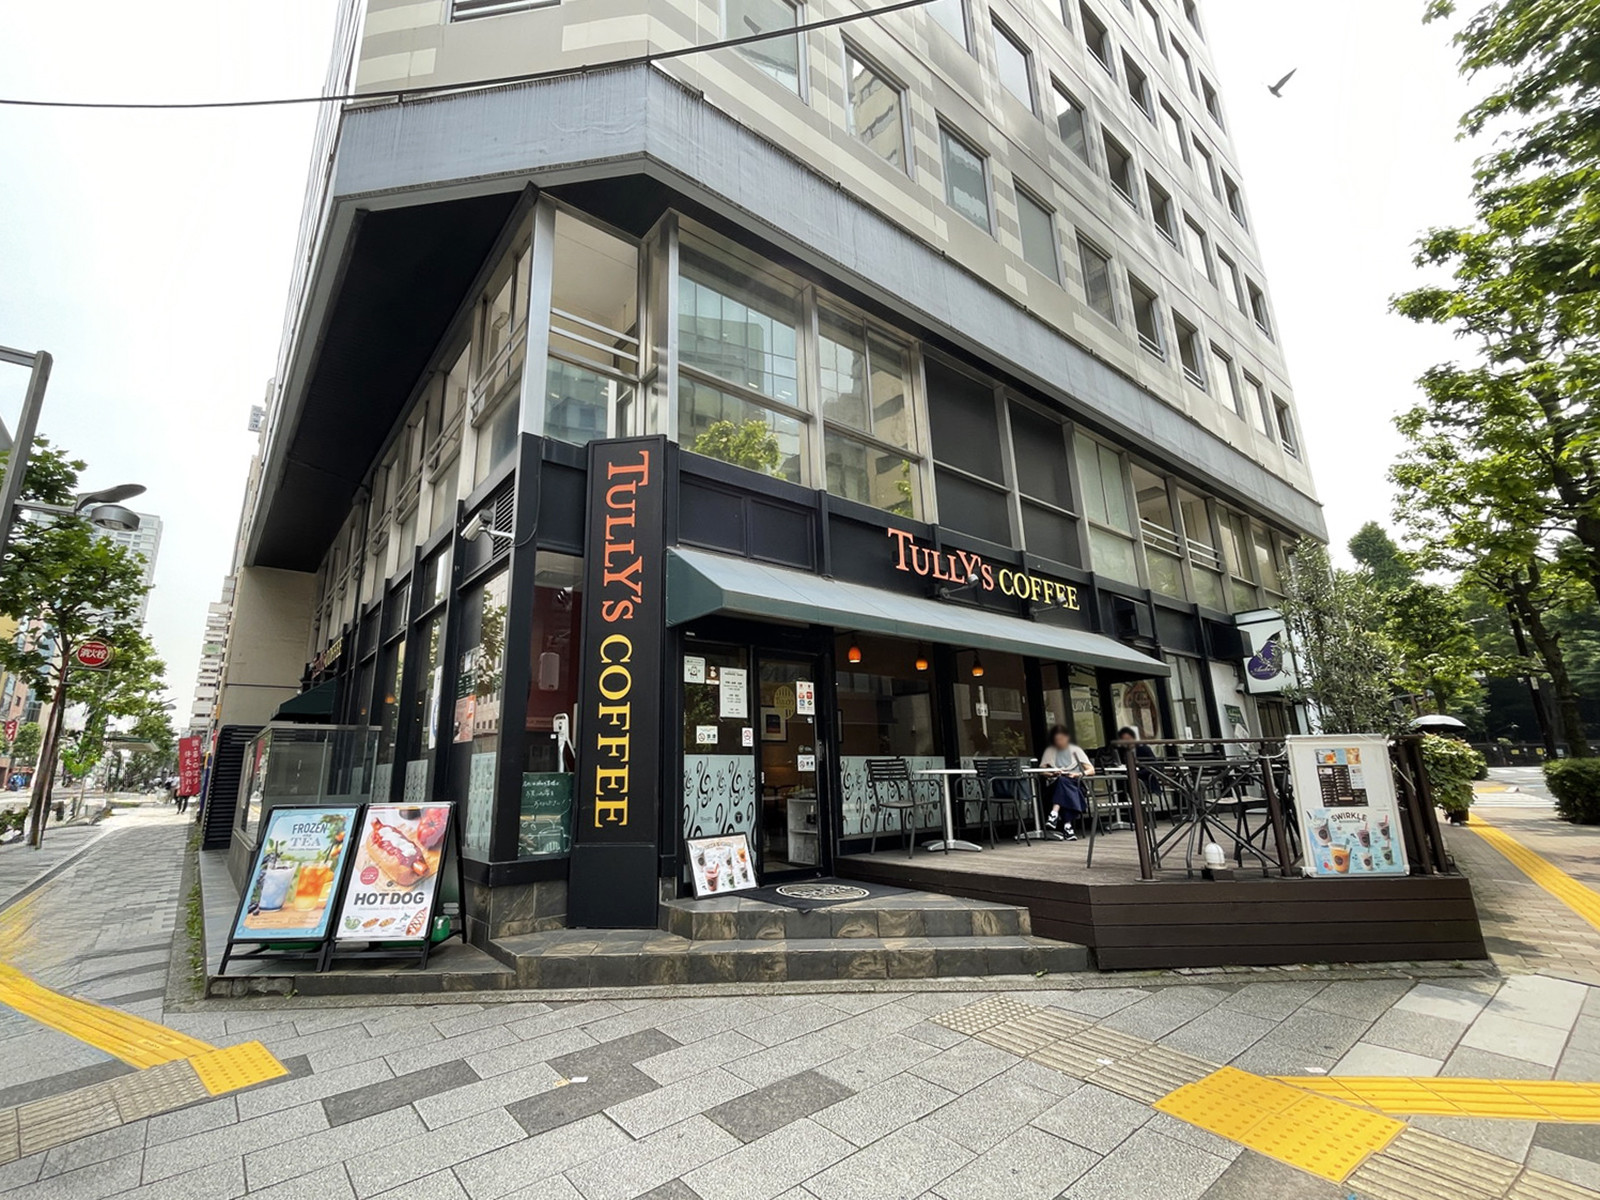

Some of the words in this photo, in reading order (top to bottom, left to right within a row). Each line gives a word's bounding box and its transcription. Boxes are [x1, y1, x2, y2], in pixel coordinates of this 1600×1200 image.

[602, 450, 650, 622] TULLY'S
[887, 527, 995, 591] TULLY'S
[999, 568, 1080, 611] COFFEE
[80, 648, 107, 659] 消火栓
[595, 634, 633, 828] COFFEE
[1330, 812, 1367, 822] SWIRKLE
[292, 822, 328, 834] FROZEN
[290, 837, 321, 847] TEA
[354, 893, 389, 905] HOT
[390, 892, 425, 905] DOG
